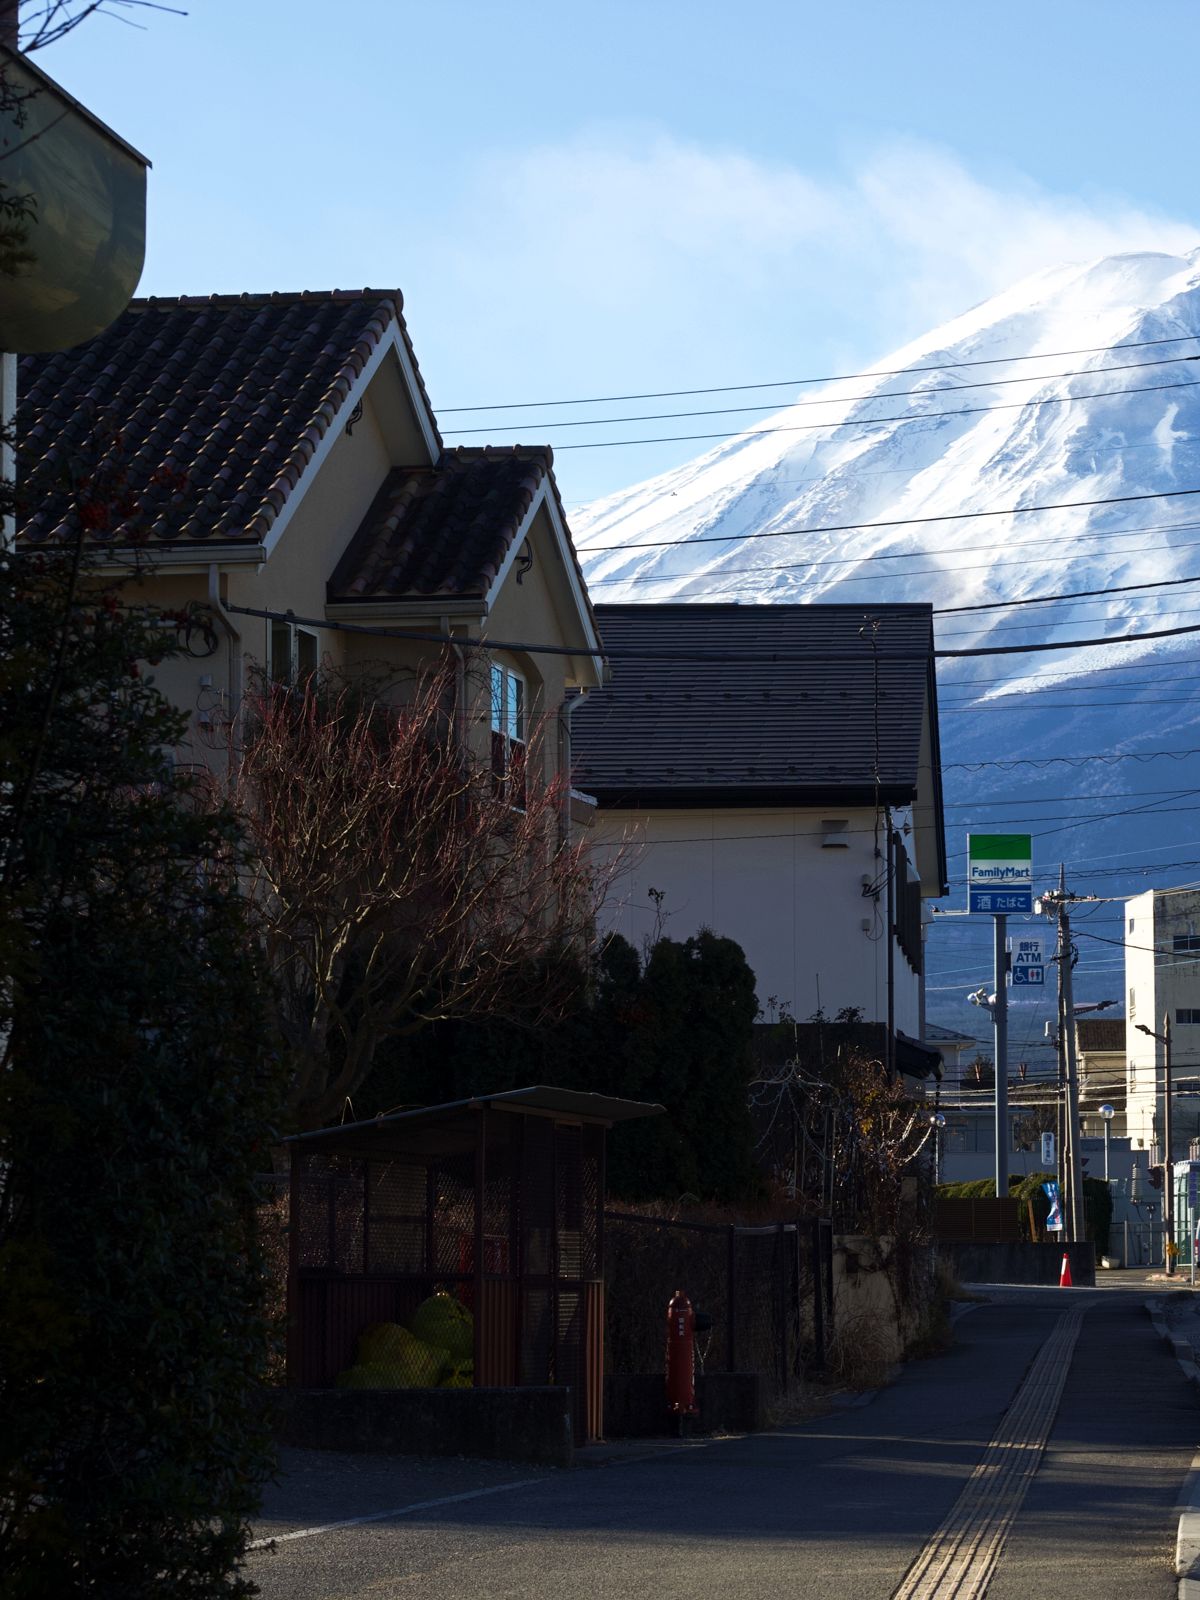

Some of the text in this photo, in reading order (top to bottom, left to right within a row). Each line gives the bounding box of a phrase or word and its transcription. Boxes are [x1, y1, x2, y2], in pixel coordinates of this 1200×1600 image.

[972, 867, 1030, 879] FamilyMart
[977, 895, 1026, 910] 酒 たばこ
[1019, 941, 1039, 952] 銀行
[1016, 952, 1042, 963] ATM
